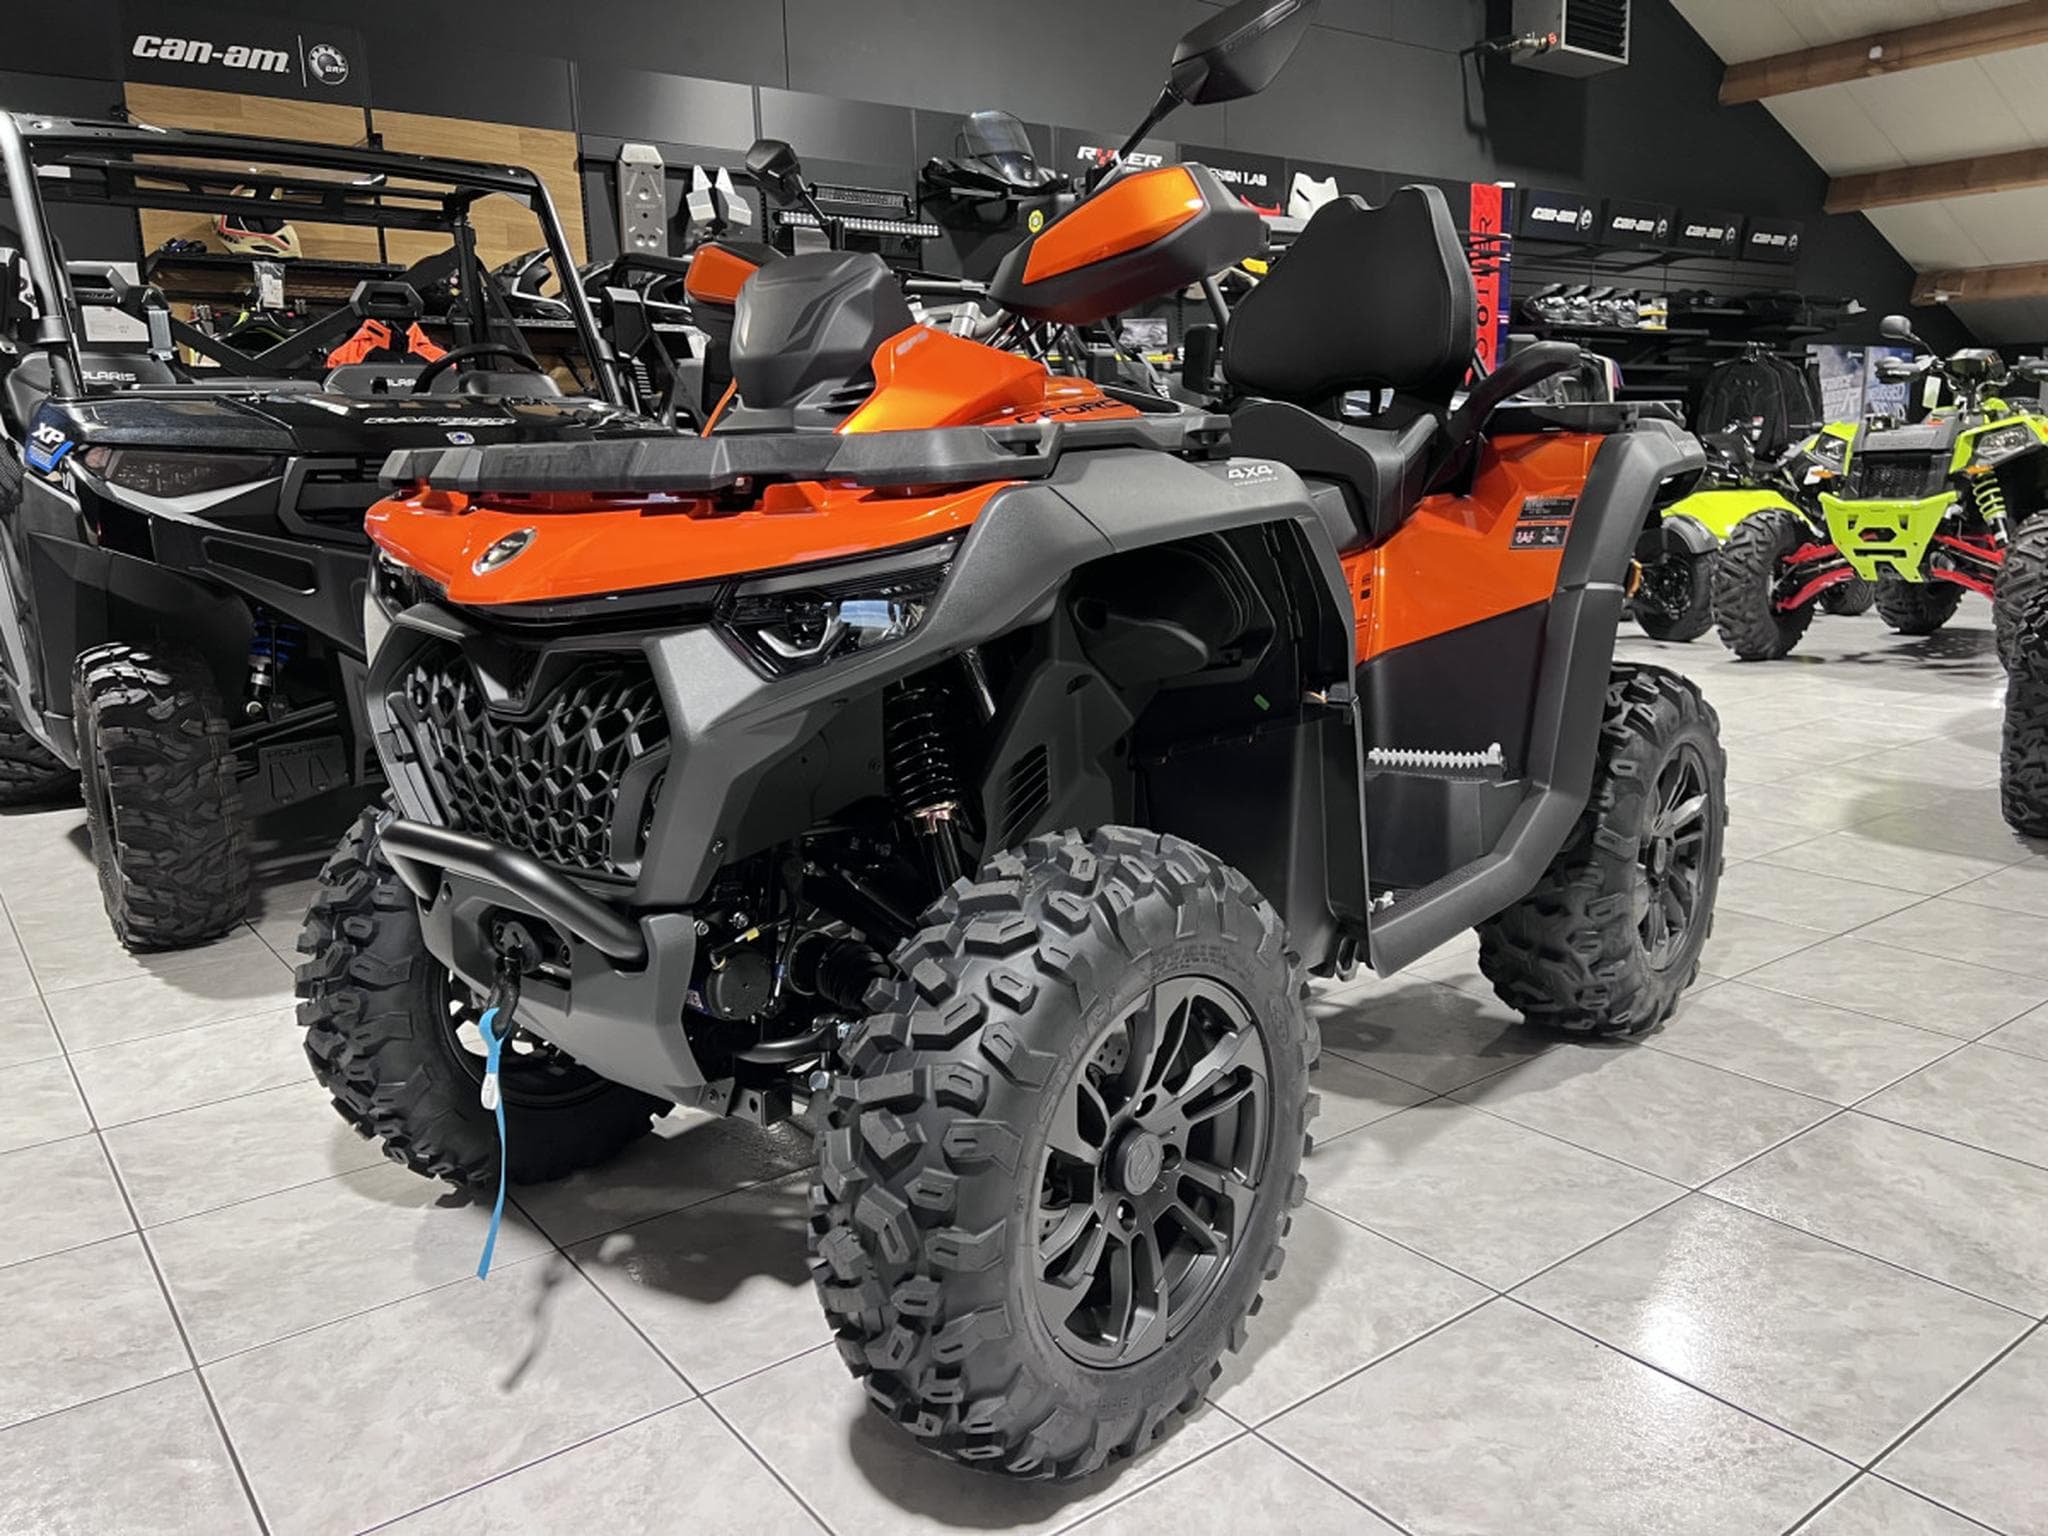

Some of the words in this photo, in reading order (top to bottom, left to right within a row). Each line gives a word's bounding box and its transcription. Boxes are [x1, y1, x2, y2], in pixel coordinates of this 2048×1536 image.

[132, 35, 290, 74] can-am
[1243, 171, 1268, 187] LAB
[81, 371, 137, 382] OLARIS
[31, 422, 66, 445] XP
